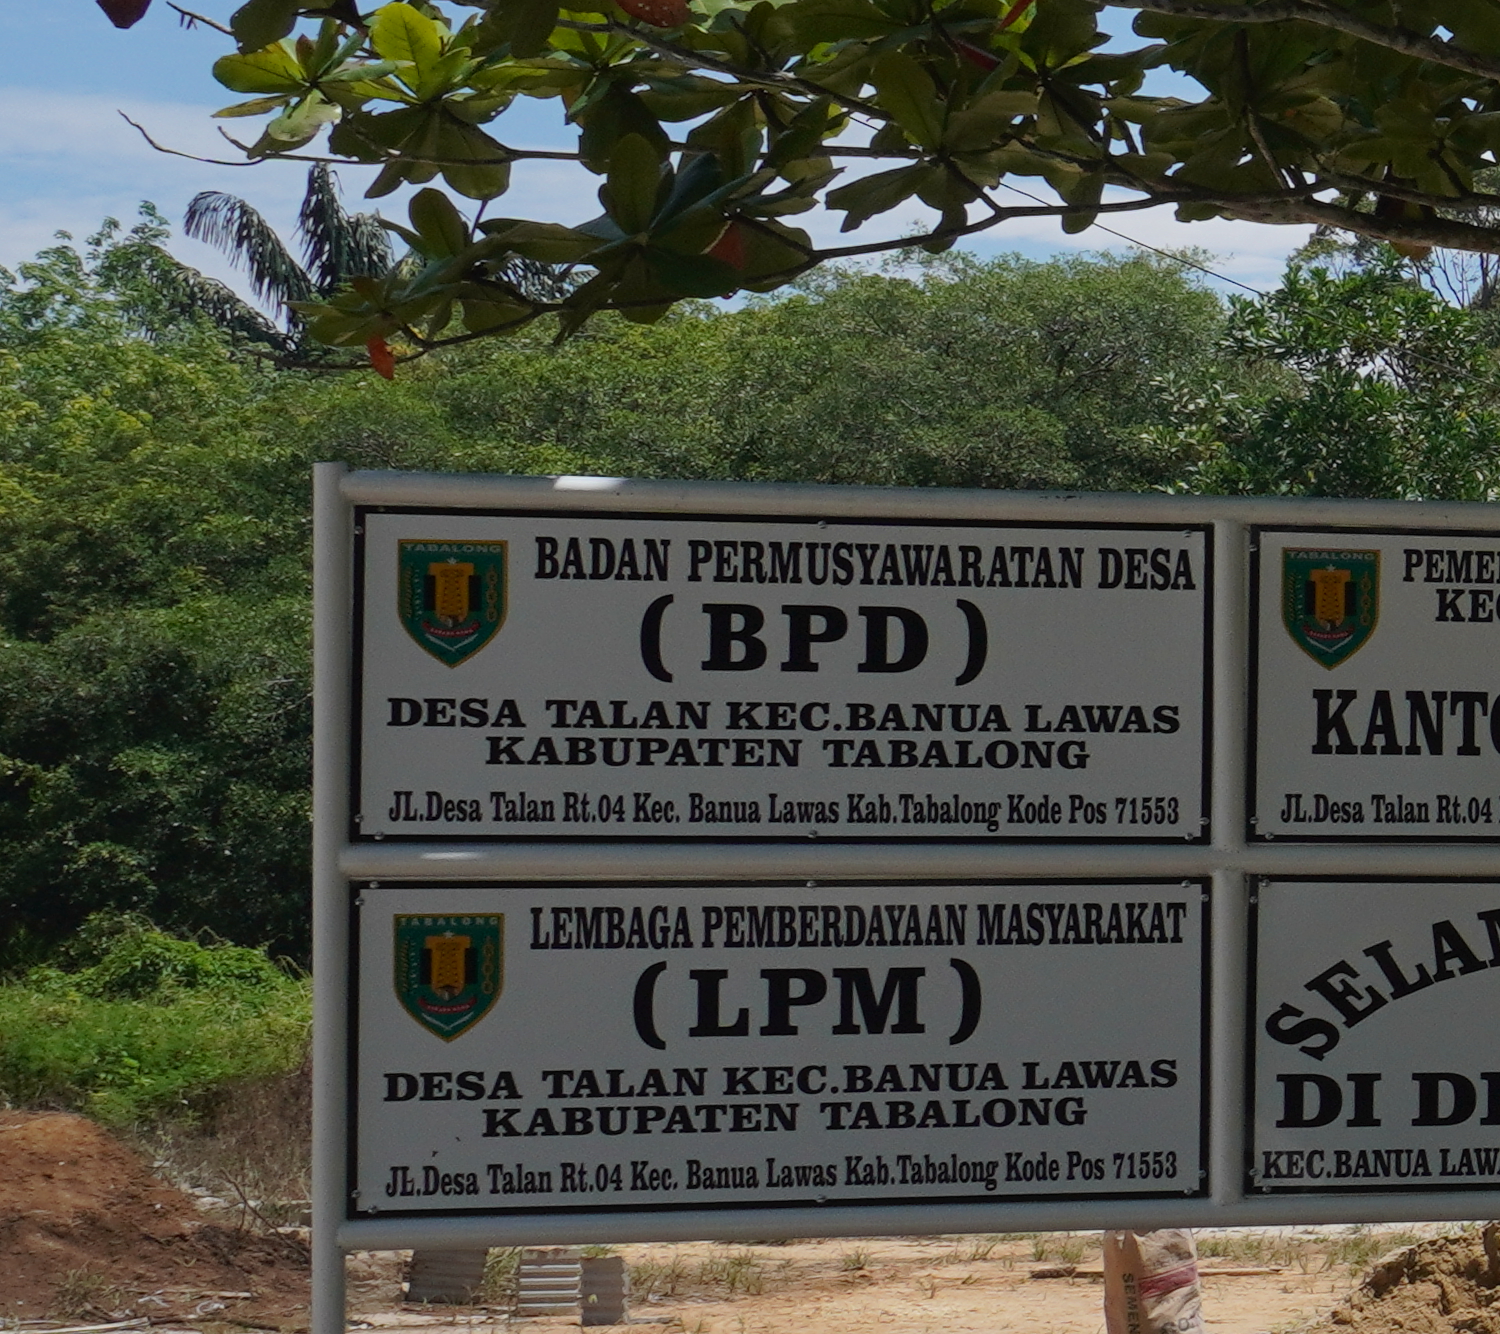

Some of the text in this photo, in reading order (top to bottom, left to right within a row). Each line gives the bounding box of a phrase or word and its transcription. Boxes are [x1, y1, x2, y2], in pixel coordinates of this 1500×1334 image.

[534, 536, 1196, 592] BADAN PERMUSYAWARATAN DESA
[386, 697, 527, 729] DESA
[545, 699, 711, 730] TALAN
[1024, 704, 1180, 735] LAWAS
[485, 736, 1091, 770] KABUPATEN TABALONG
[489, 791, 556, 823] Talan
[562, 791, 626, 823] Rt.04
[632, 792, 680, 824] Kec.
[688, 792, 762, 824] Banua
[767, 792, 840, 824] Lawas
[1006, 793, 1062, 825] Kode
[1068, 794, 1107, 825] Pos
[1115, 796, 1179, 825] 71553
[1370, 794, 1431, 824] Talan
[1435, 794, 1493, 824] Rt.04
[529, 902, 1187, 950] LEMBAGA PEMBERDAYAAN MASYARAKAT
[383, 1070, 523, 1102] DESA
[541, 1067, 708, 1099] TALAN
[1021, 1058, 1178, 1090] LAWAS
[1275, 1072, 1382, 1129] DI
[481, 1096, 1088, 1138] KABUPATEN TABALONG
